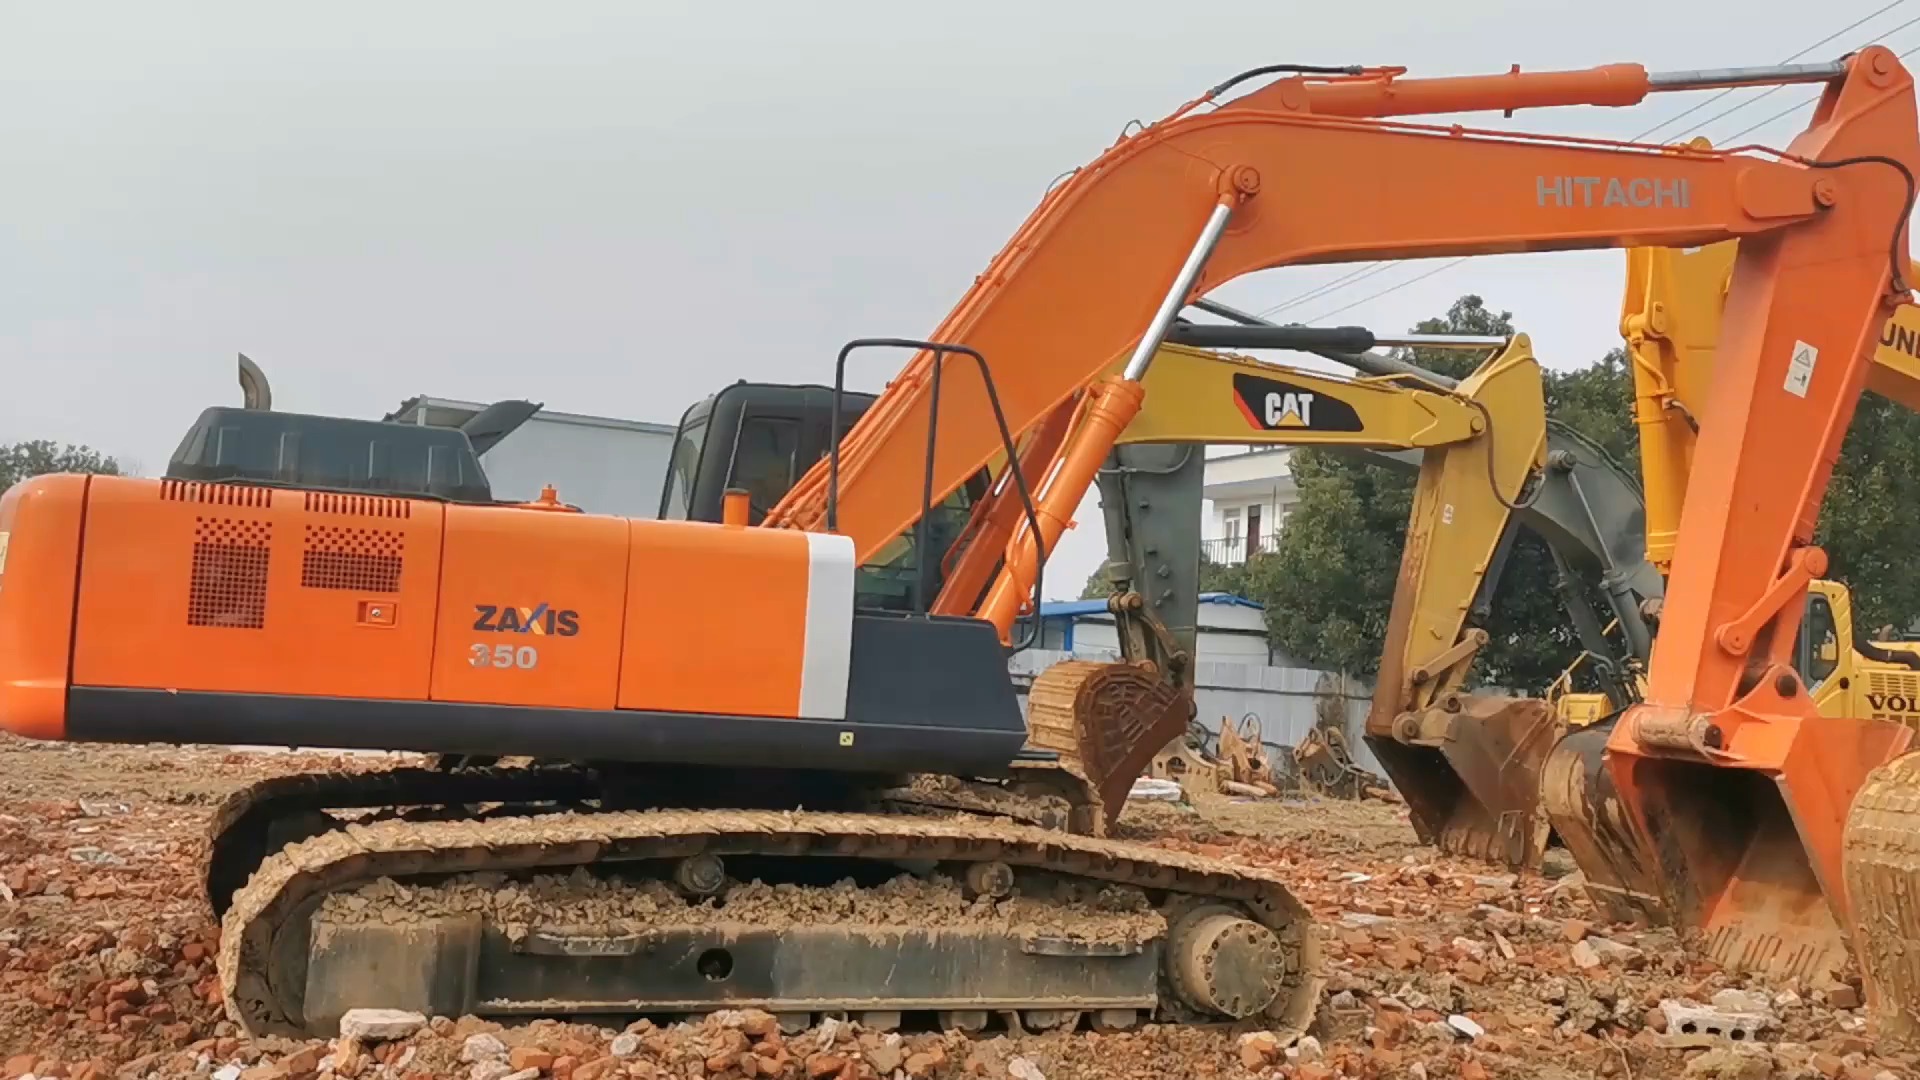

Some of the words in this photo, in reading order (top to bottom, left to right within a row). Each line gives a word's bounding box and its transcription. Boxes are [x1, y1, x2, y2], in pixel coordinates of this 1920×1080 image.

[1536, 176, 1690, 209] HITACHI
[1265, 392, 1314, 427] CAT
[473, 602, 580, 637] ZAXIS
[468, 643, 538, 669] 350
